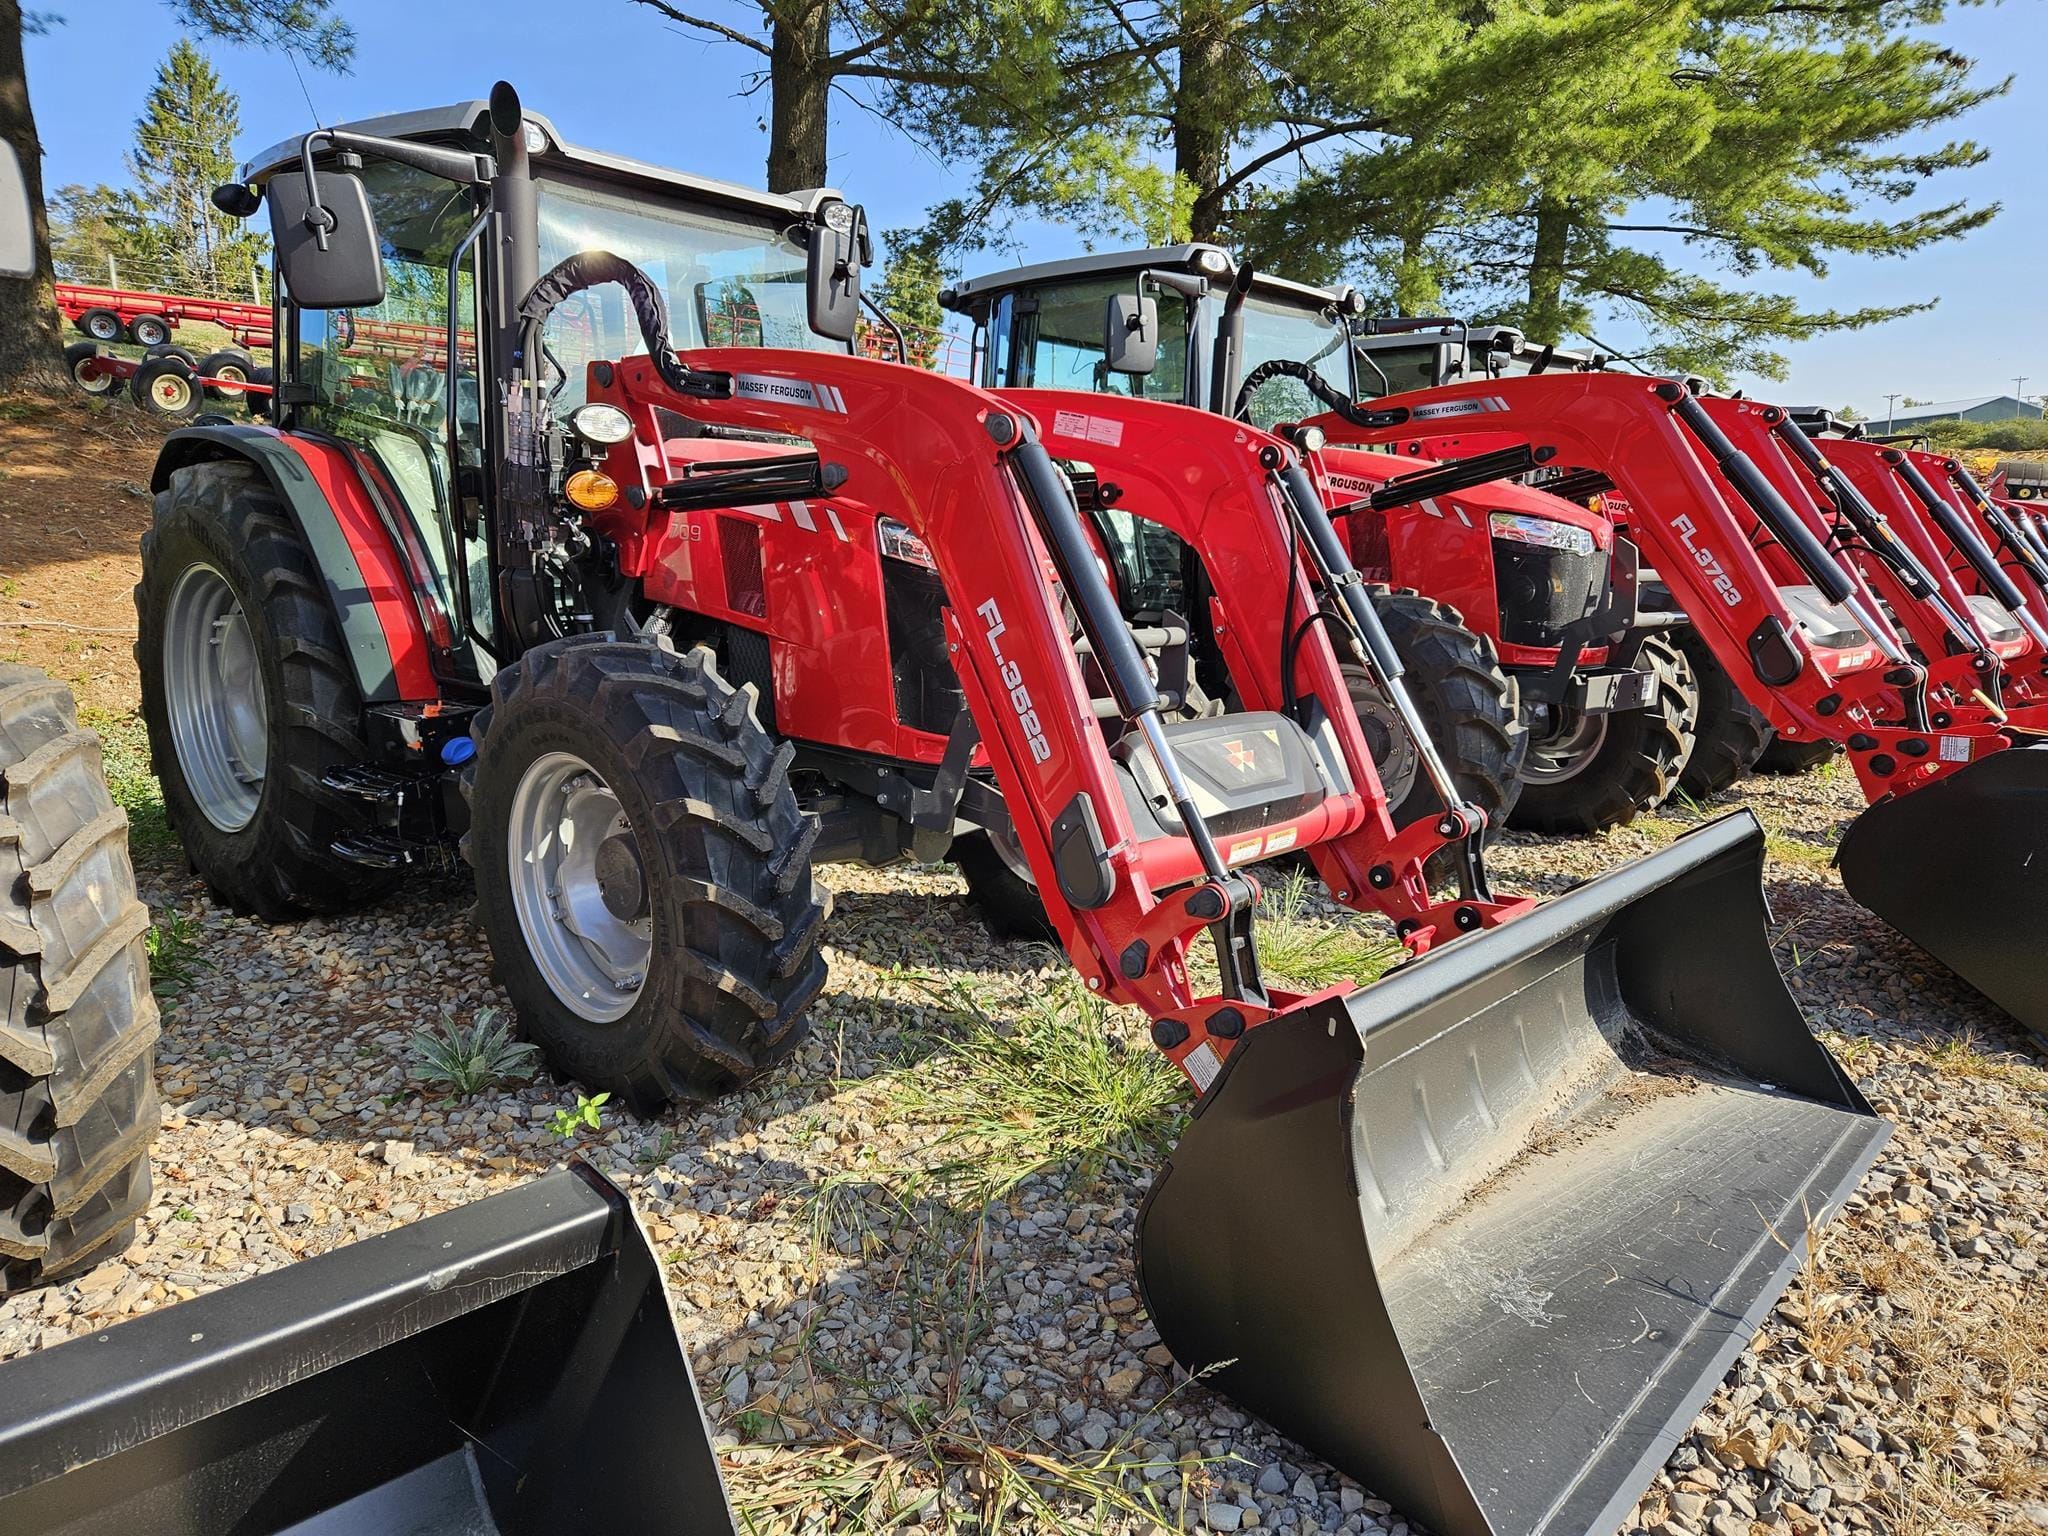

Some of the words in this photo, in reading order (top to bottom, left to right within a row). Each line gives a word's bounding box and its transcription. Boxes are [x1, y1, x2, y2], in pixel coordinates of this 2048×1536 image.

[738, 381, 768, 394] MASSEY
[770, 384, 812, 400] FERGUSON
[1412, 408, 1440, 417] MASSEY
[1441, 403, 1478, 413] FERGUSON
[1328, 476, 1375, 493] RGUSON
[1670, 513, 1742, 606] FL.3723
[976, 597, 1051, 765] FL.3522
